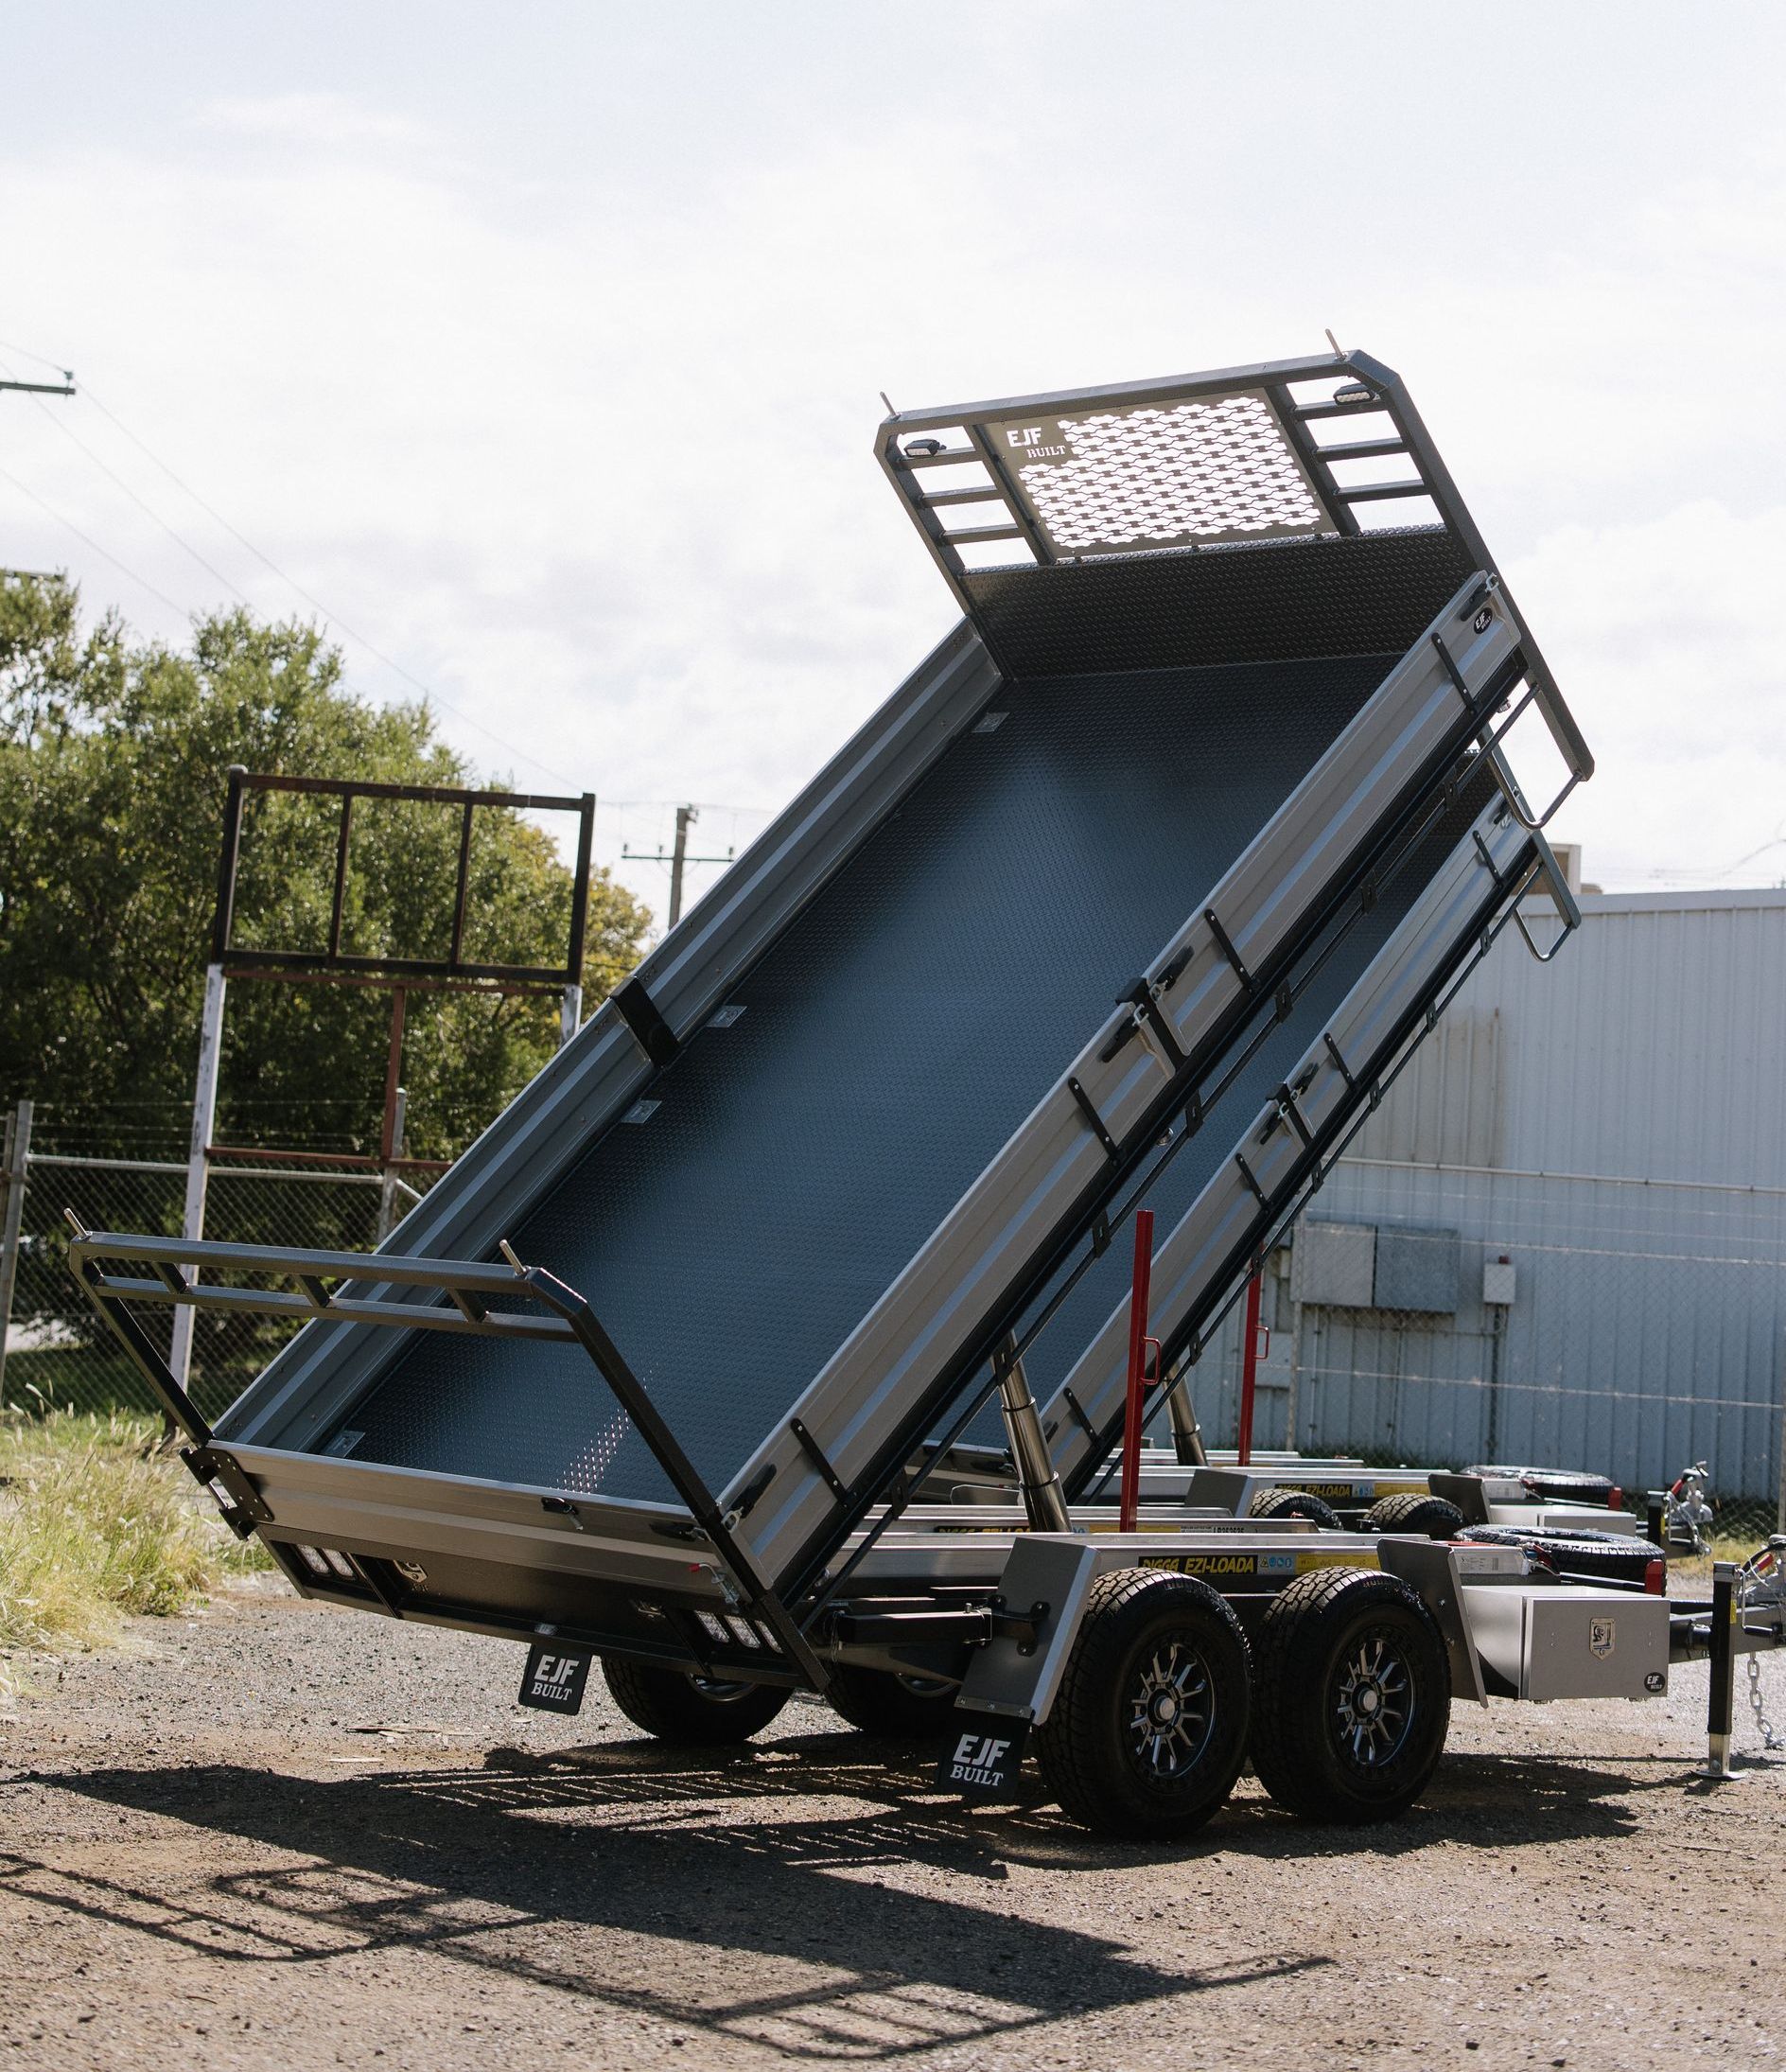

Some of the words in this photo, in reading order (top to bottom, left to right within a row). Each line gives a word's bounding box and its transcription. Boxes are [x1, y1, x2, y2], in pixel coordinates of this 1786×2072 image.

[1007, 427, 1042, 448] EJF
[1476, 611, 1485, 630] EJF
[534, 1655, 580, 1685] EJF
[1647, 1675, 1660, 1685] EJF
[531, 1682, 572, 1701] BUILT
[953, 1733, 1011, 1768] EJF
[950, 1765, 1004, 1786] BUILT
